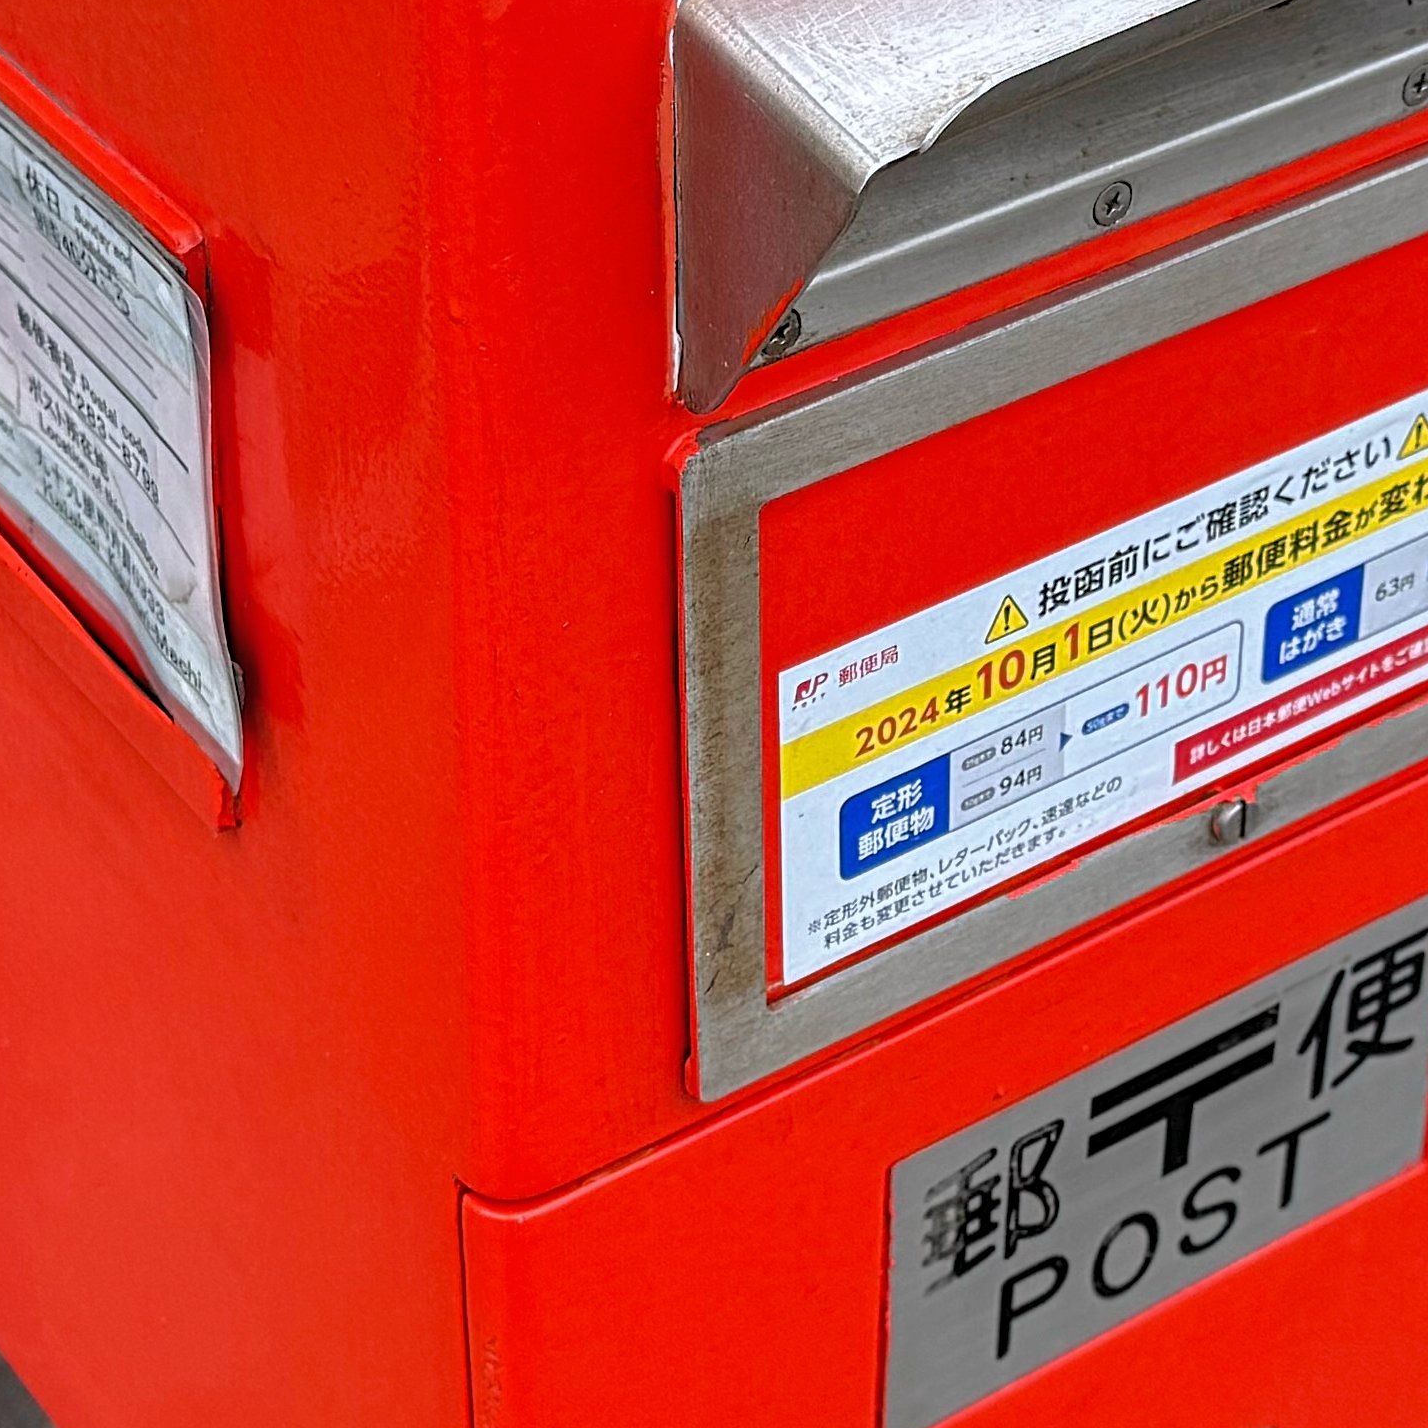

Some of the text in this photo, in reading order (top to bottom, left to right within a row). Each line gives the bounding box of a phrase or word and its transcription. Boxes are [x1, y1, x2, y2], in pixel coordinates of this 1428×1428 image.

[24, 161, 61, 221] 休日
[80, 371, 118, 429] Postal
[121, 420, 148, 464] code
[1038, 429, 1393, 618] 投函前にご確認ください
[1290, 585, 1340, 632] 通常
[1373, 569, 1415, 605] 63円
[838, 643, 899, 688] 郵便局
[1278, 612, 1348, 666] はがき
[1133, 646, 1228, 722] 110円
[1000, 723, 1043, 757] 84円
[870, 777, 922, 825] 定形
[999, 763, 1042, 797] 94円
[857, 804, 934, 863] 郵便物
[996, 1110, 1332, 1361] POST
